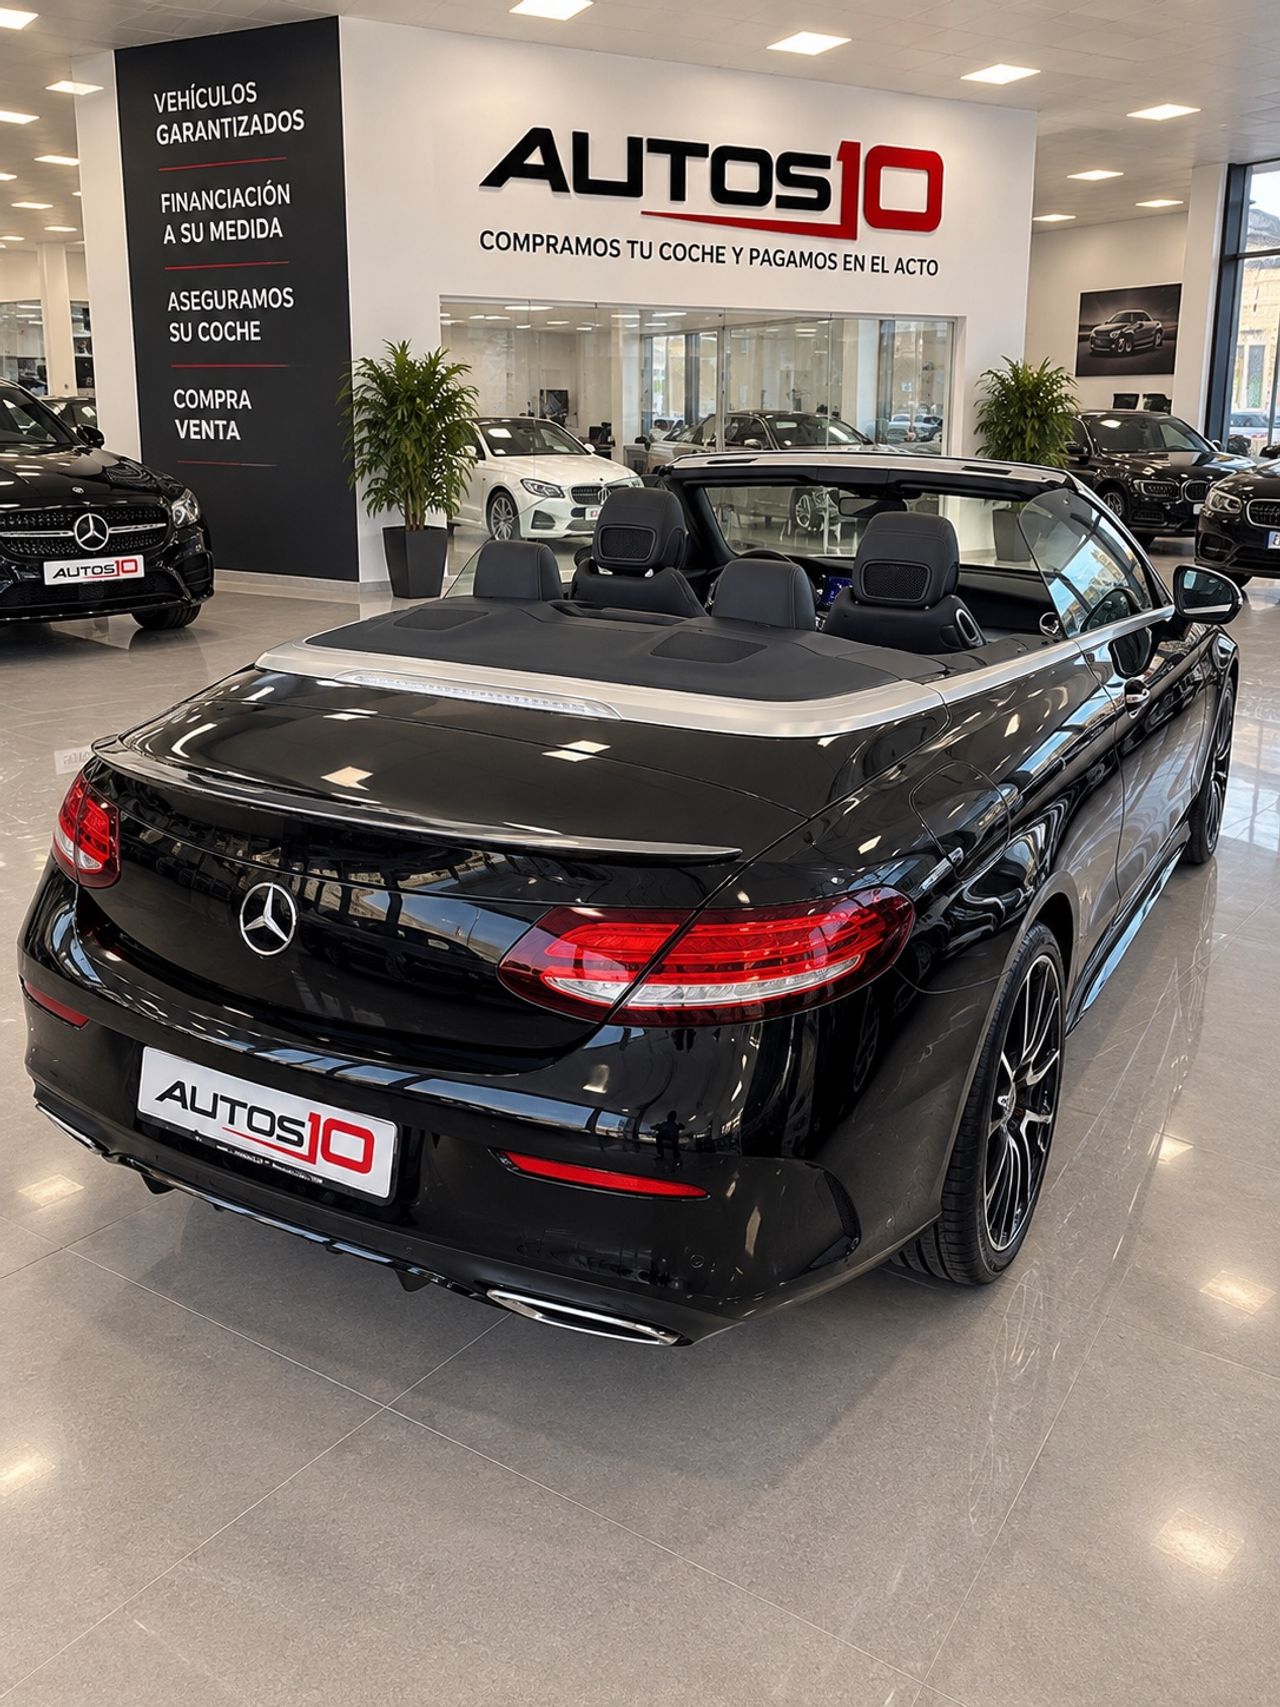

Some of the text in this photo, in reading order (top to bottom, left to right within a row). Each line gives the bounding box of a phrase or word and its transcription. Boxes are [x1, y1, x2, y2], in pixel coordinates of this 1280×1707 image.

[154, 82, 257, 113] VEHÍCULOS
[157, 109, 304, 144] GARANTIZADOS
[161, 180, 290, 213] FINANCIACIÓN
[479, 128, 944, 241] AUTOS10
[164, 217, 283, 245] A SU MEDIDA
[479, 229, 939, 276] COMPRAMOS TU COCHE Y PAGAMOS EN EL ACTO
[168, 287, 293, 311] ASEGURAMOS
[170, 321, 261, 342] SU COCHE
[173, 389, 252, 409] COMPRA
[175, 420, 241, 440] VENTA
[52, 558, 139, 579] AUTOS10
[155, 1080, 375, 1175] AUTOS10
